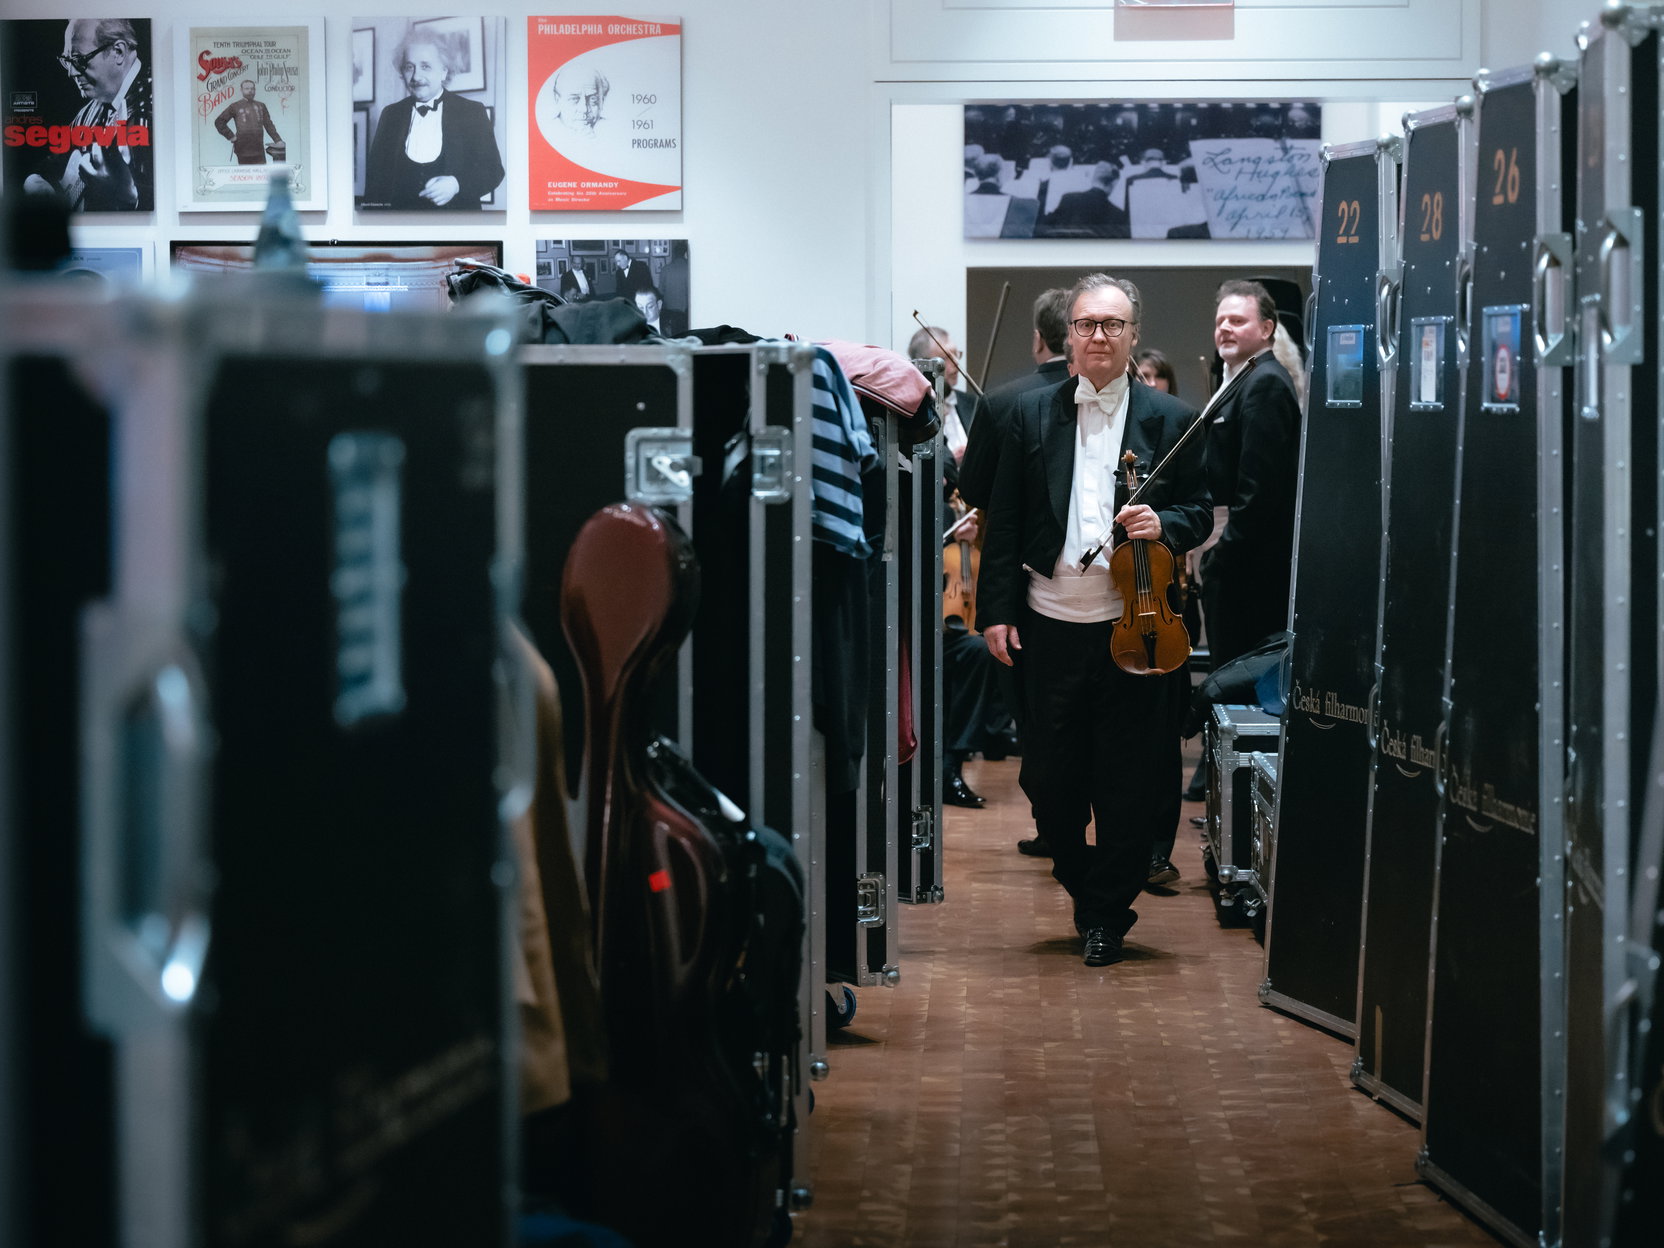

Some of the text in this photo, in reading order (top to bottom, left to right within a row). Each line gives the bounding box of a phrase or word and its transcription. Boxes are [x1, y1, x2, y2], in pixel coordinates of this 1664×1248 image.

[538, 24, 661, 35] PHILADELPHIA ORCHESTRA
[206, 64, 249, 93] GRAND CONCERT
[198, 86, 235, 121] BAND
[632, 94, 657, 105] 1960
[4, 120, 149, 154] segovia
[632, 119, 654, 130] 1961
[632, 138, 677, 149] PROGRAMS
[1492, 148, 1520, 205] 26
[1336, 200, 1361, 243] 22
[1420, 192, 1443, 242] 28
[1292, 679, 1321, 715] Česká
[1380, 719, 1407, 761] Česká
